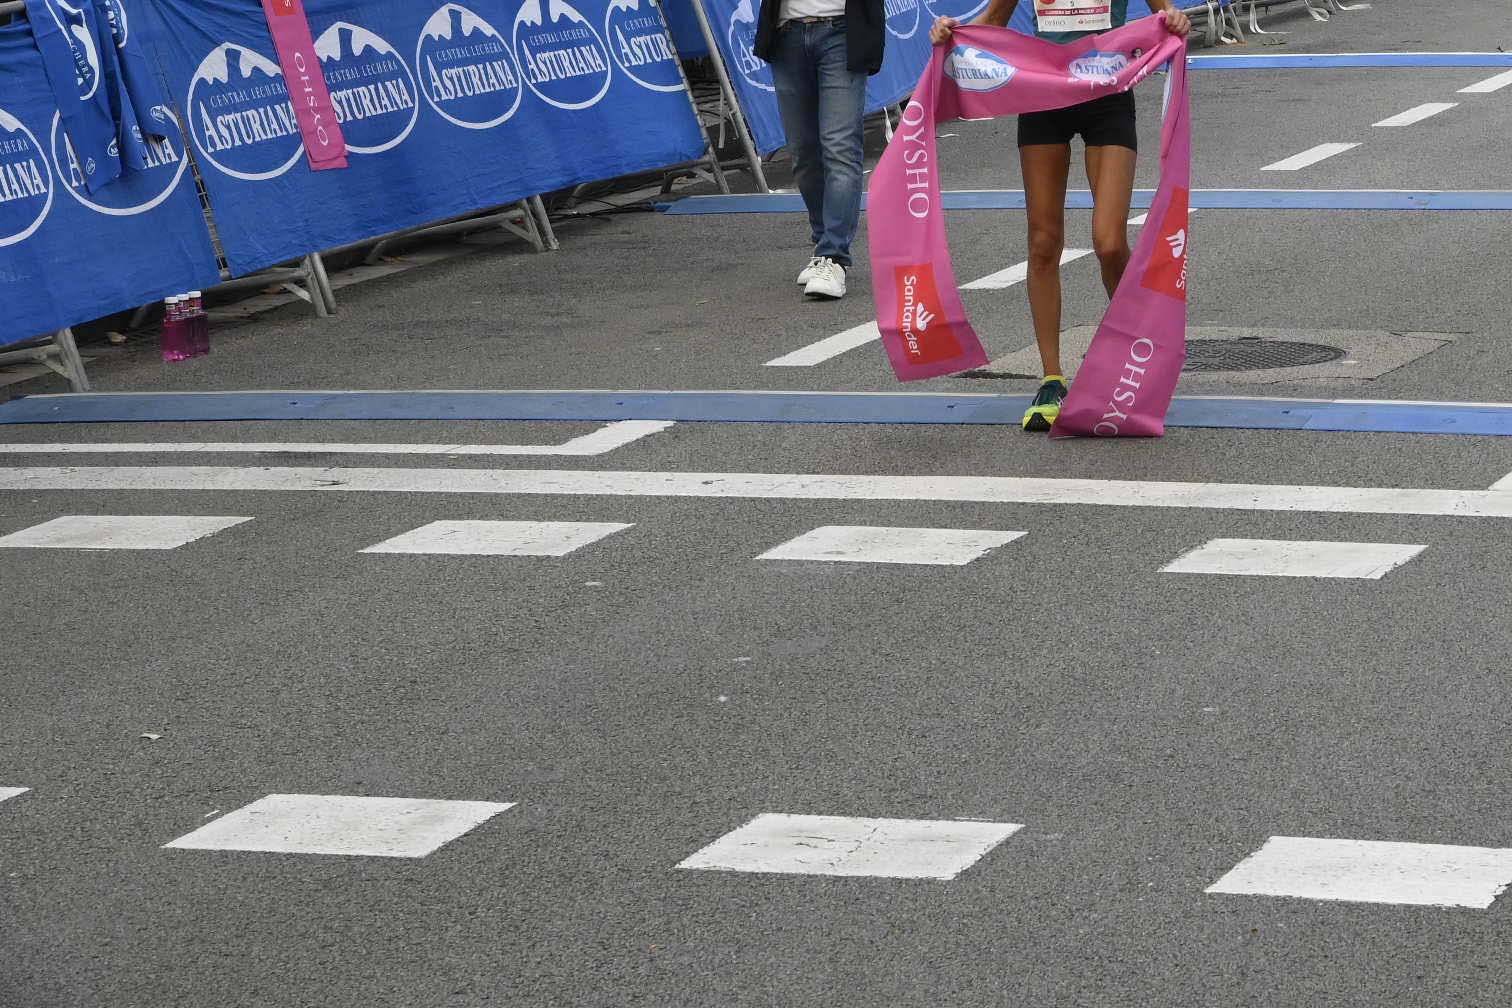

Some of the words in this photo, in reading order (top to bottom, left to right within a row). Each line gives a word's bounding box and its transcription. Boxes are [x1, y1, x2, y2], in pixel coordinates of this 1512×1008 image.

[529, 33, 558, 47] CENTRAL
[559, 28, 590, 42] LECHERA
[614, 23, 675, 68] ASTUR
[623, 16, 657, 31] CENTRAL
[324, 69, 361, 85] CENTRAL
[362, 60, 399, 77] LECHERA
[436, 47, 468, 62] CENTRAL
[471, 41, 503, 55] LECHERA
[521, 39, 607, 84] ASTURIANA
[210, 89, 250, 109] CENTRAL
[294, 51, 330, 146] OYSHO
[329, 77, 414, 124] STURIANA
[427, 54, 518, 102] ASTURIANA
[199, 100, 300, 154] ASTURIANA
[901, 100, 930, 219] OYSHO
[901, 275, 921, 357] Santander
[1093, 337, 1155, 437] OYSHO
